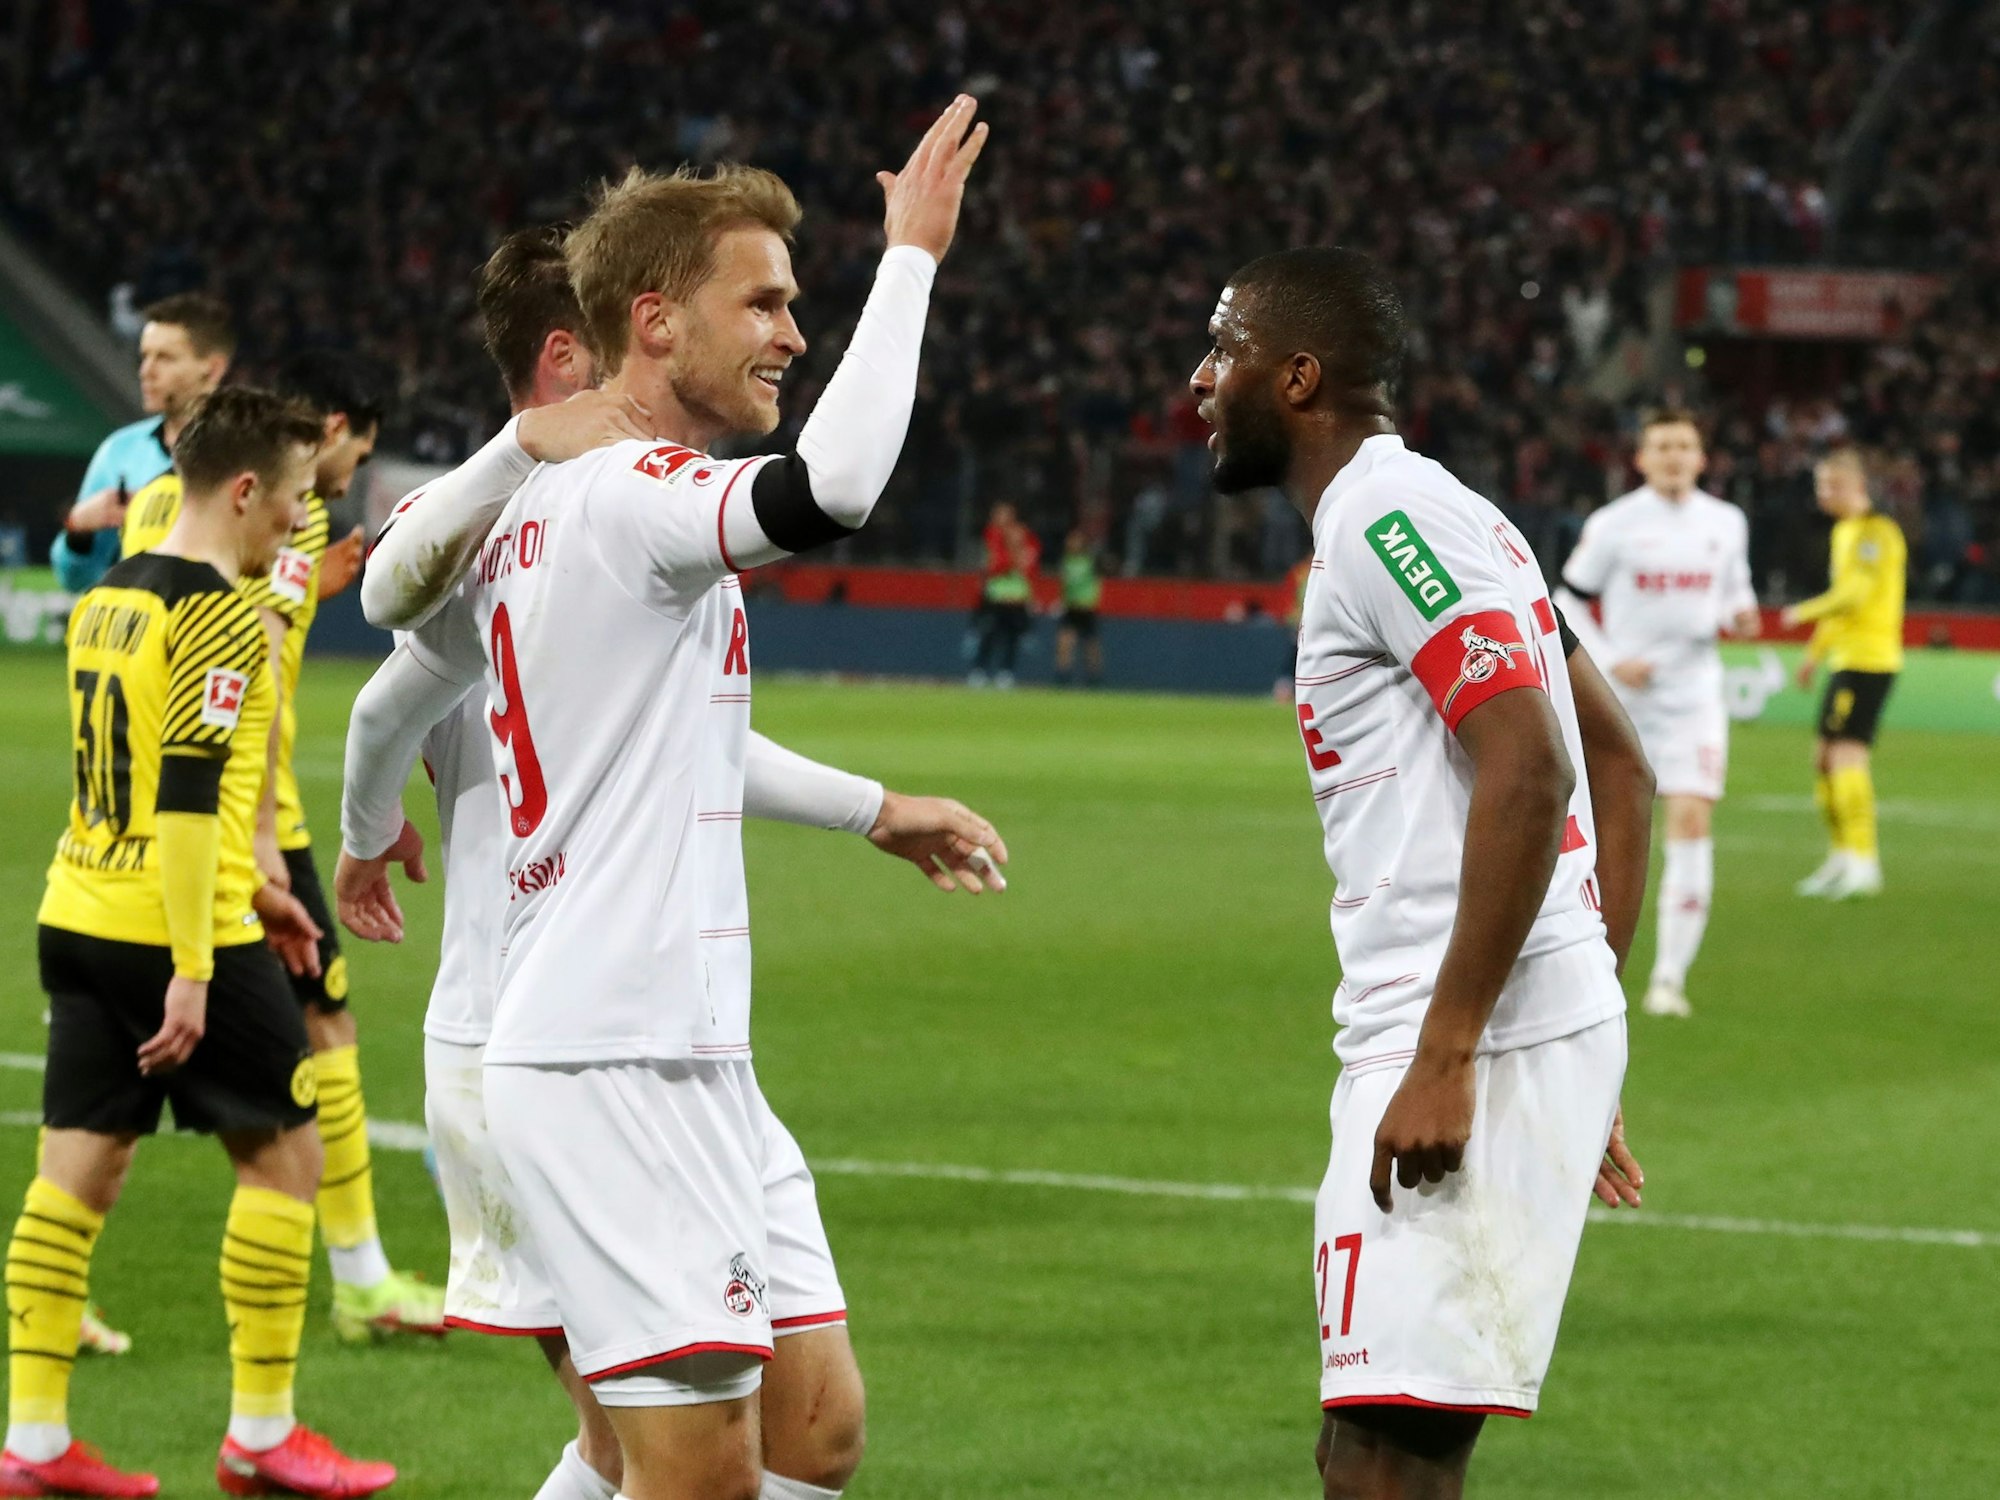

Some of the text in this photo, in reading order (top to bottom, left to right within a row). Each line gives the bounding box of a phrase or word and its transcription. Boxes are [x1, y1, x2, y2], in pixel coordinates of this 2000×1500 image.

[1376, 520, 1448, 608] DEVK
[723, 607, 749, 676] R
[74, 668, 132, 836] 30
[490, 601, 548, 839] 9
[1297, 702, 1342, 772] E
[1315, 1232, 1363, 1341] 27
